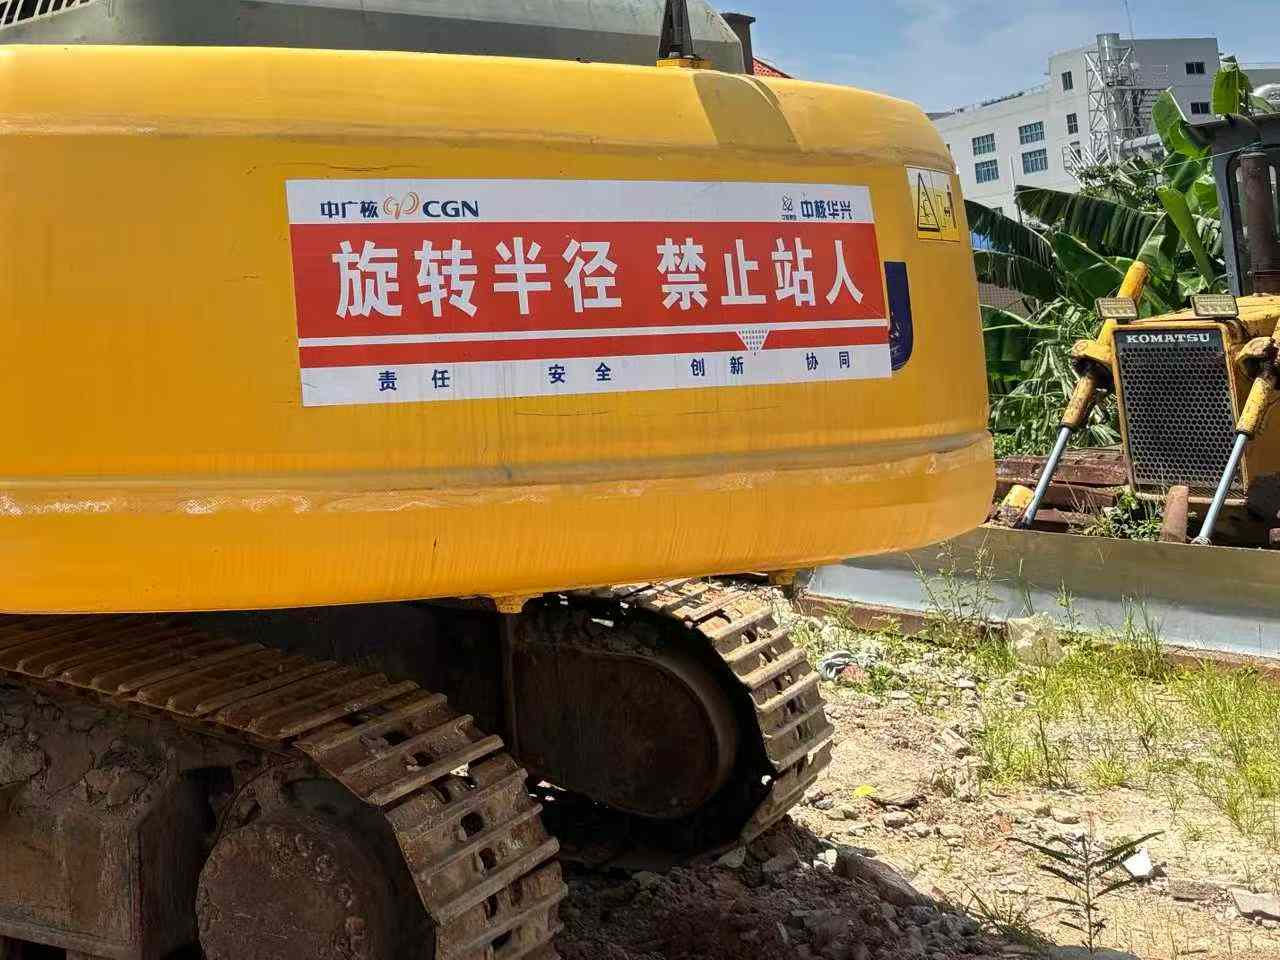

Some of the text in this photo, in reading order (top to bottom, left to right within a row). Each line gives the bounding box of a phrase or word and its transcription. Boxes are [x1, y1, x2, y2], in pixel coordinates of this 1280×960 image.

[320, 200, 480, 218] 中广核 CGN
[800, 200, 853, 220] 中核华兴
[331, 237, 864, 319] 旋转半径 禁止站人
[1126, 332, 1210, 344] KOMATSU
[378, 350, 851, 392] 责任 安全 创新 协同
